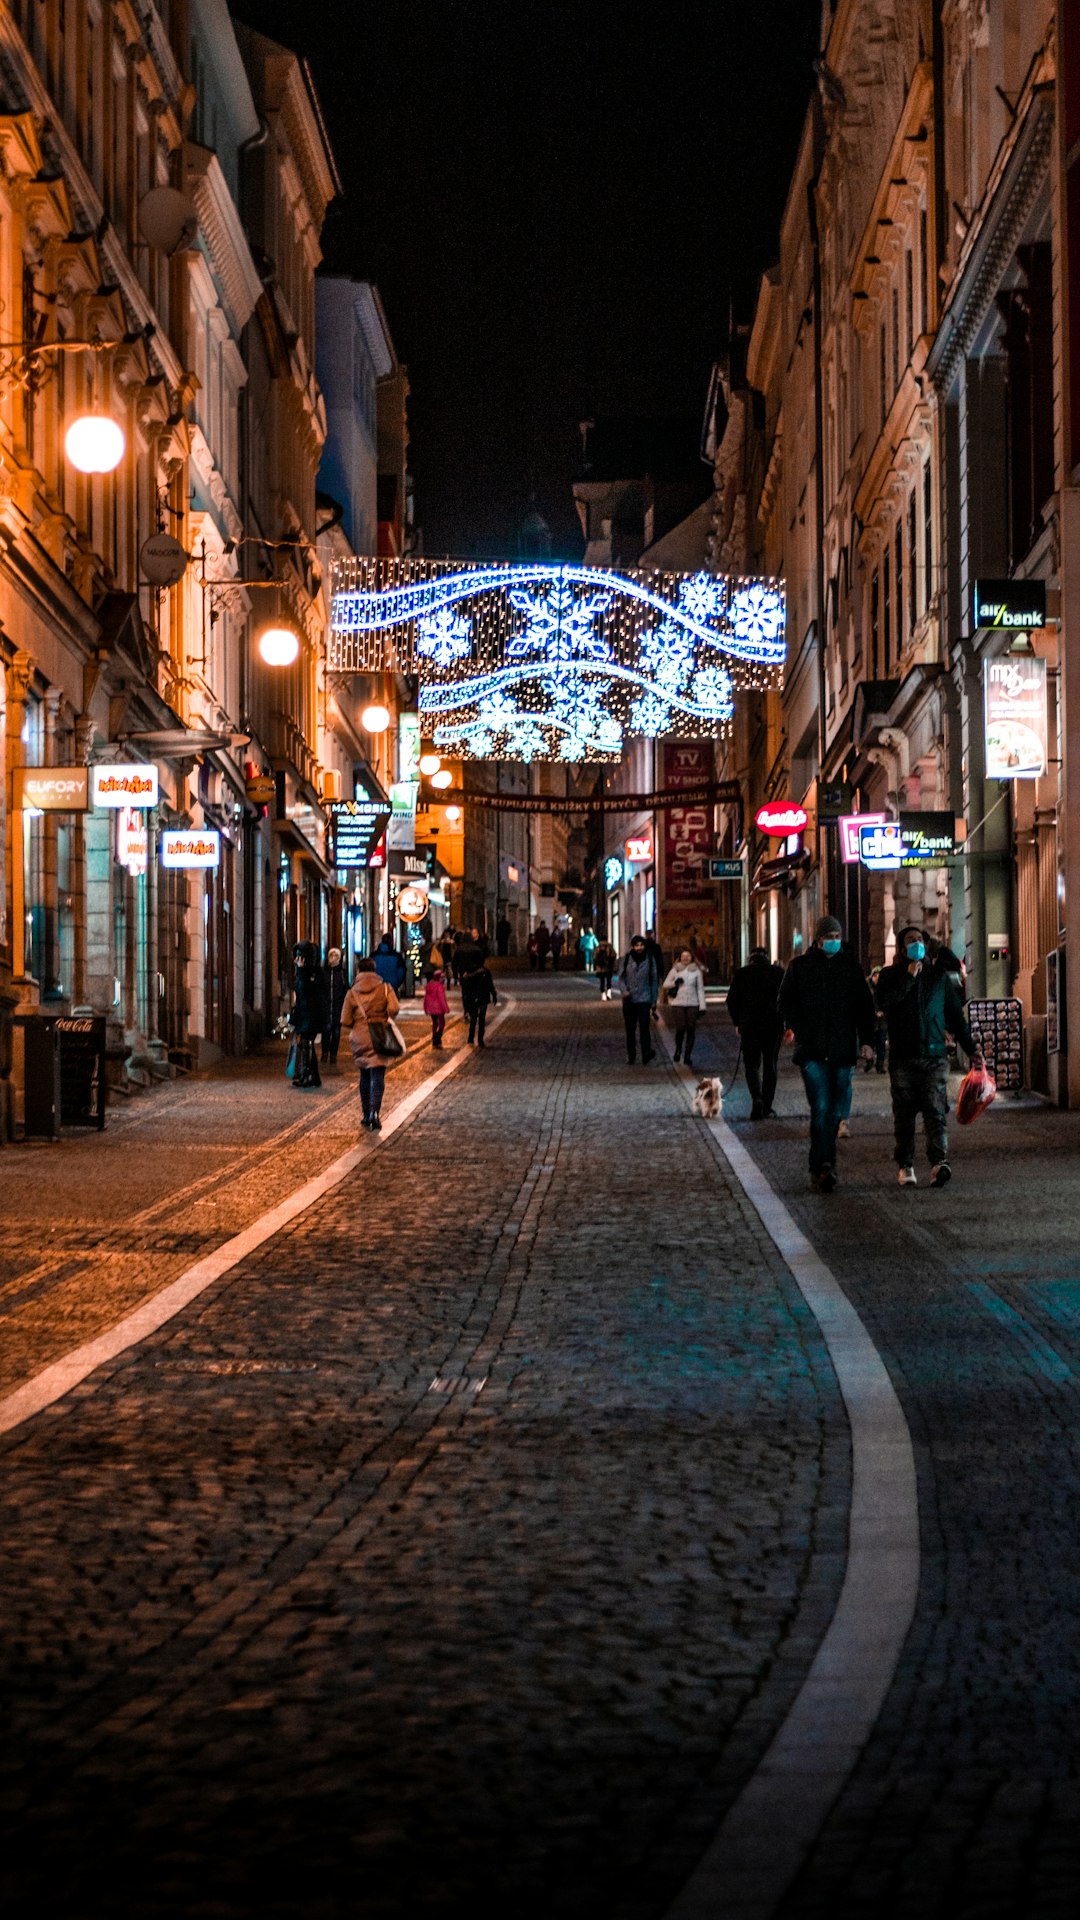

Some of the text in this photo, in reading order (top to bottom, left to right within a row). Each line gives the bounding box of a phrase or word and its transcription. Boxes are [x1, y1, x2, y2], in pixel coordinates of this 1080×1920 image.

[677, 751, 699, 765] TV
[27, 780, 85, 793] EUFORY
[668, 776, 709, 784] TV SHOP
[331, 801, 391, 815] MAXMOBIL
[491, 798, 547, 811] KUPUJETE
[592, 802, 601, 810] U
[392, 811, 413, 819] WIND
[628, 840, 651, 855] TV
